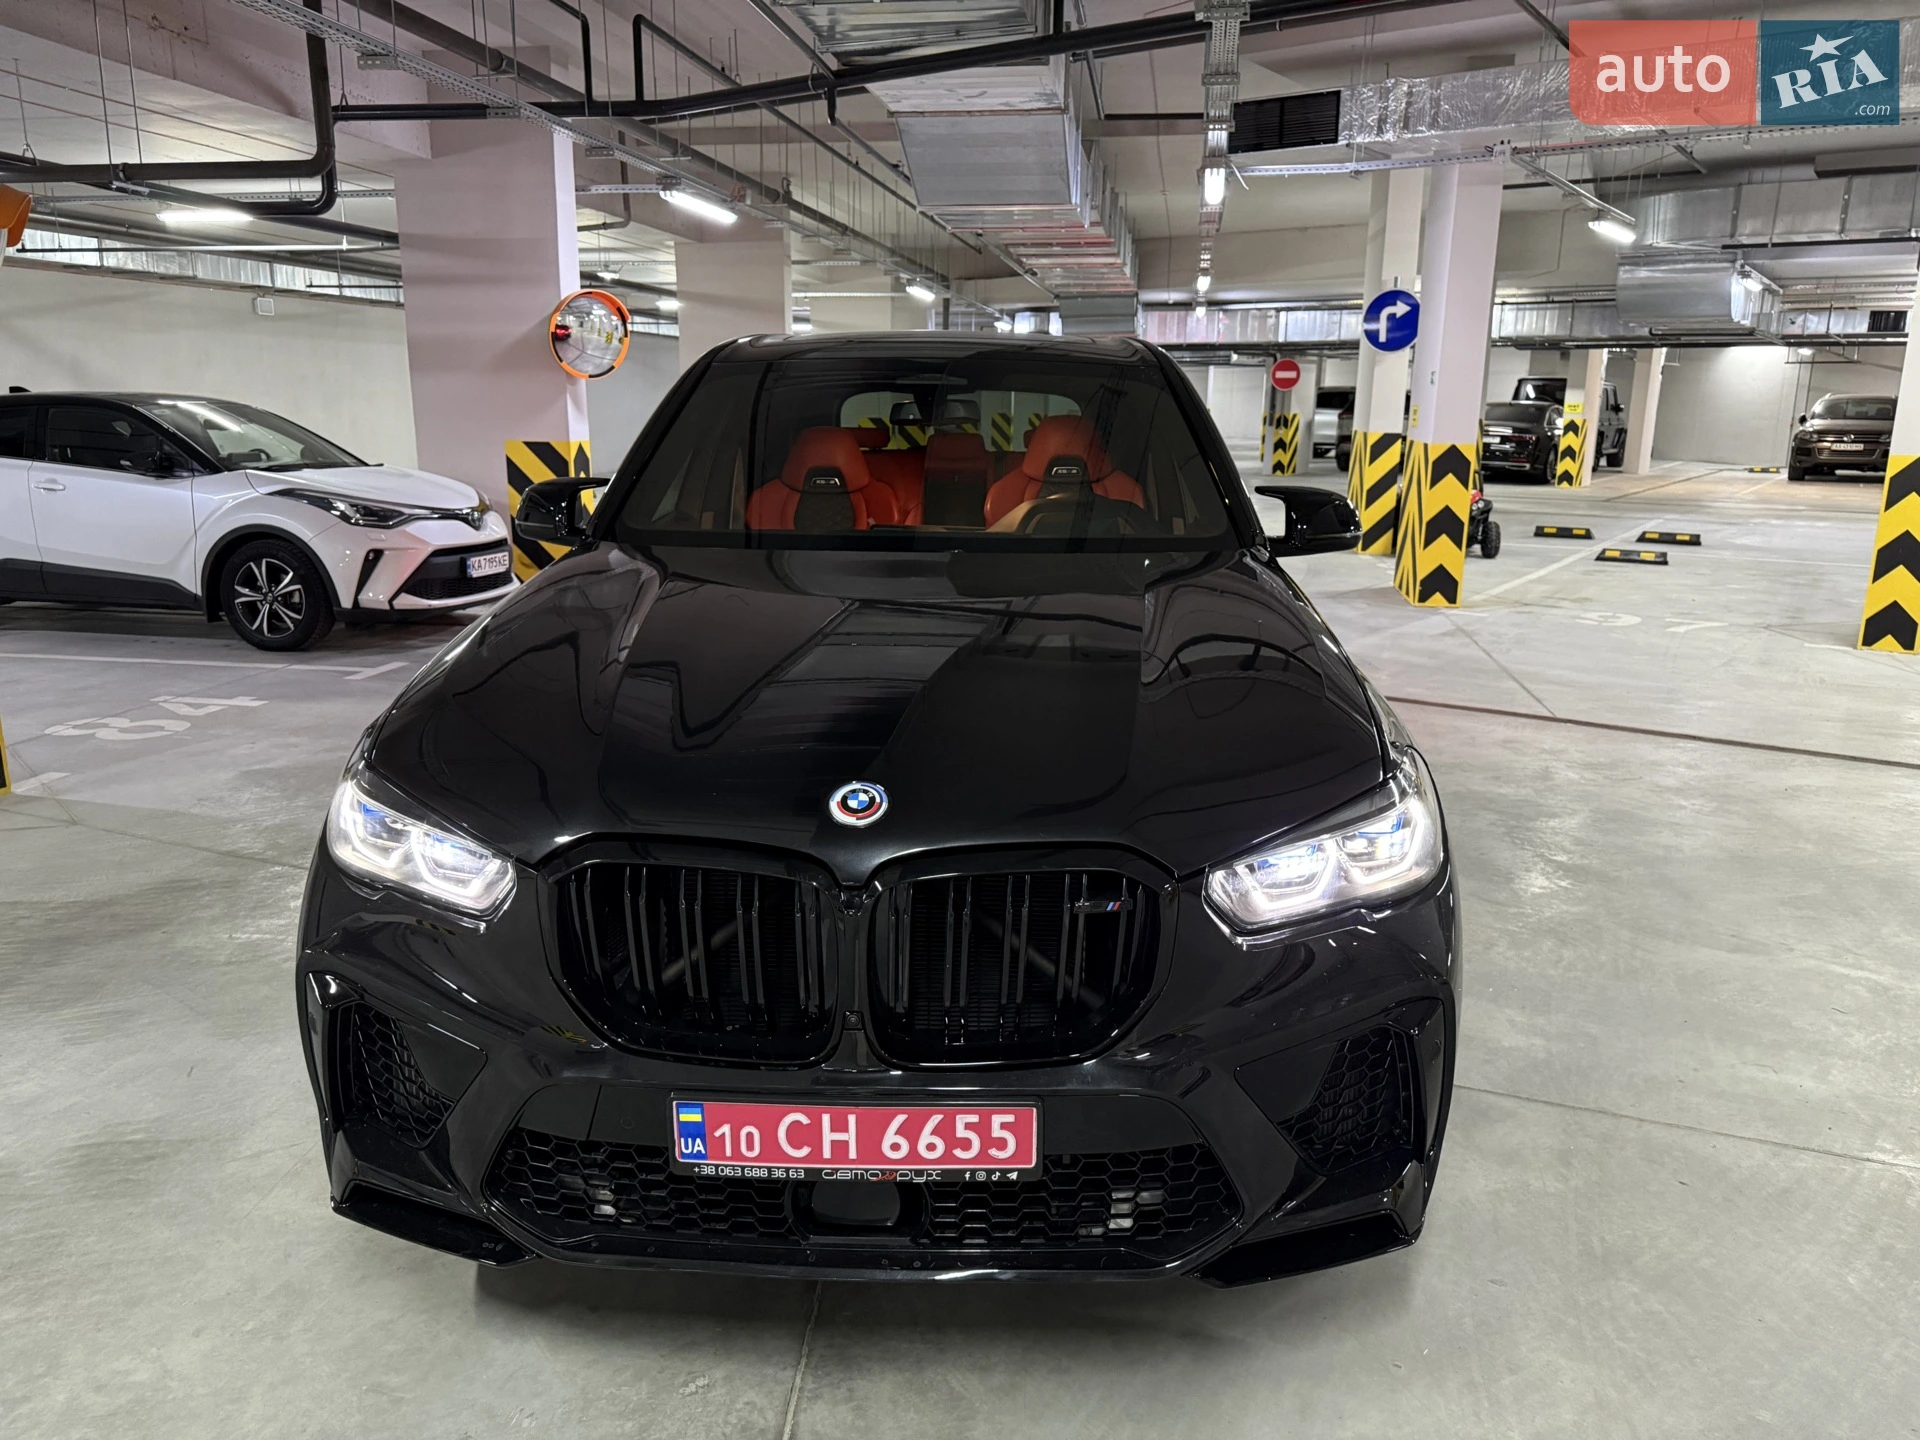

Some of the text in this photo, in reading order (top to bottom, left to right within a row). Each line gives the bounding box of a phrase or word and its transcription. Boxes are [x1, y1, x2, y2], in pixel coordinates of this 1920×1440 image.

[713, 1112, 1017, 1160] 10 CH 6655
[680, 1138, 706, 1154] UA
[693, 1165, 805, 1179] +38 063 688 36 63
